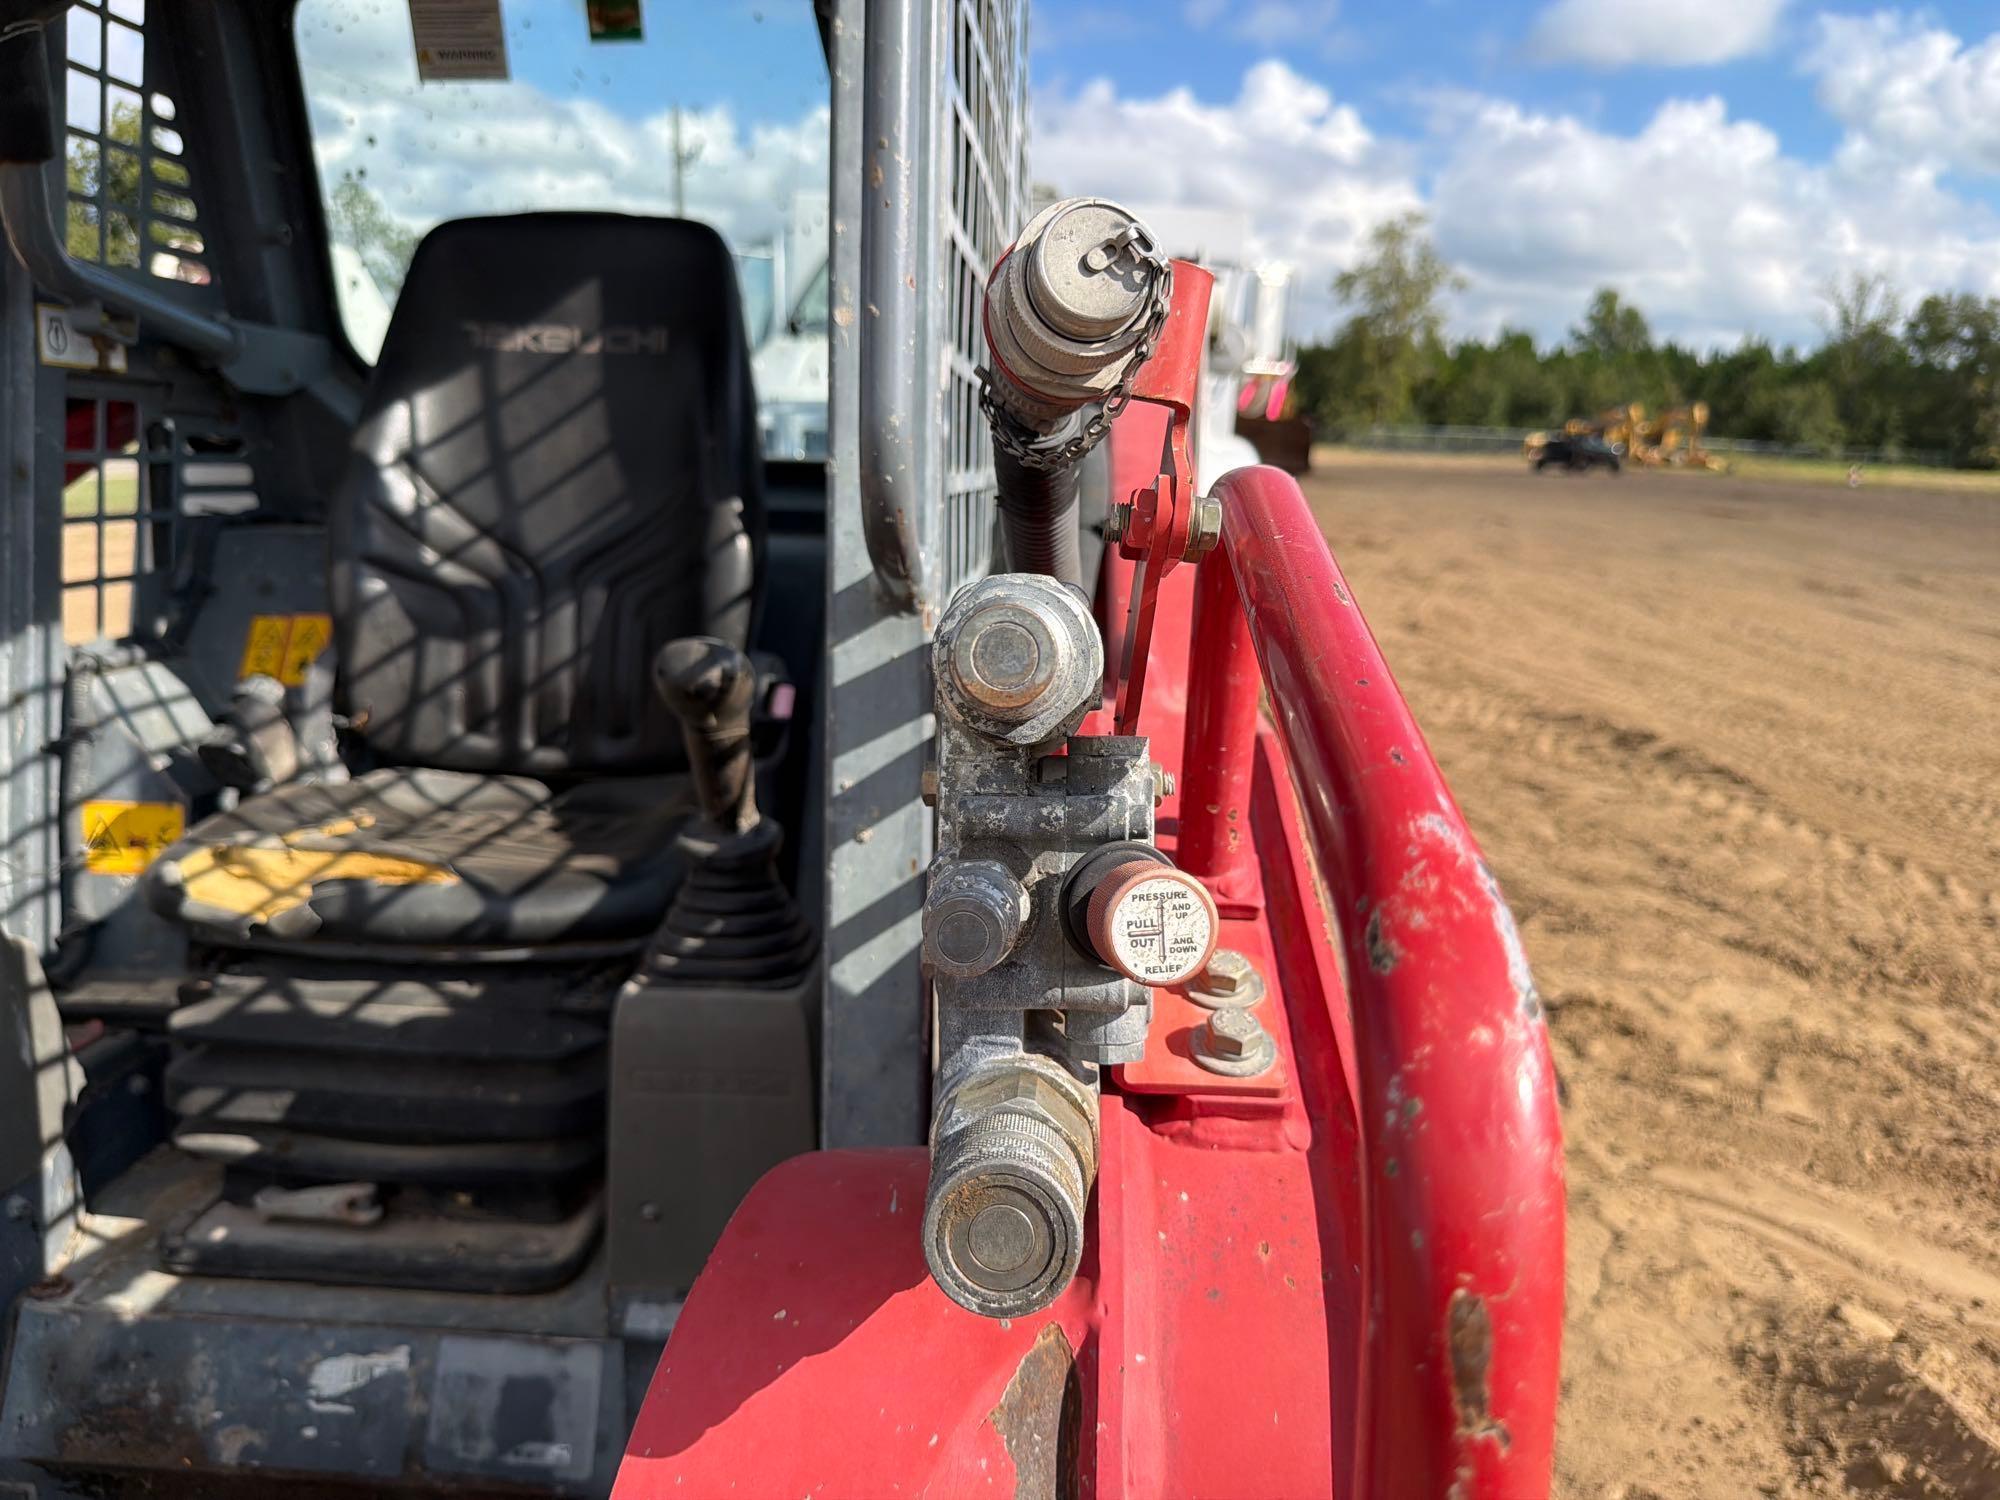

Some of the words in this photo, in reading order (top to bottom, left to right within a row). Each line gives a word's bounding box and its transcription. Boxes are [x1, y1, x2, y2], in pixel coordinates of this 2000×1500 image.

[1131, 891, 1188, 902] PRESSURE
[1172, 903, 1191, 911] AND
[1175, 911, 1188, 919] UP
[1126, 919, 1157, 929] PULL
[1130, 938, 1155, 948] OUT
[1173, 937, 1194, 945] AND
[1169, 945, 1197, 954] DOWN
[1145, 964, 1183, 975] RELIEF
